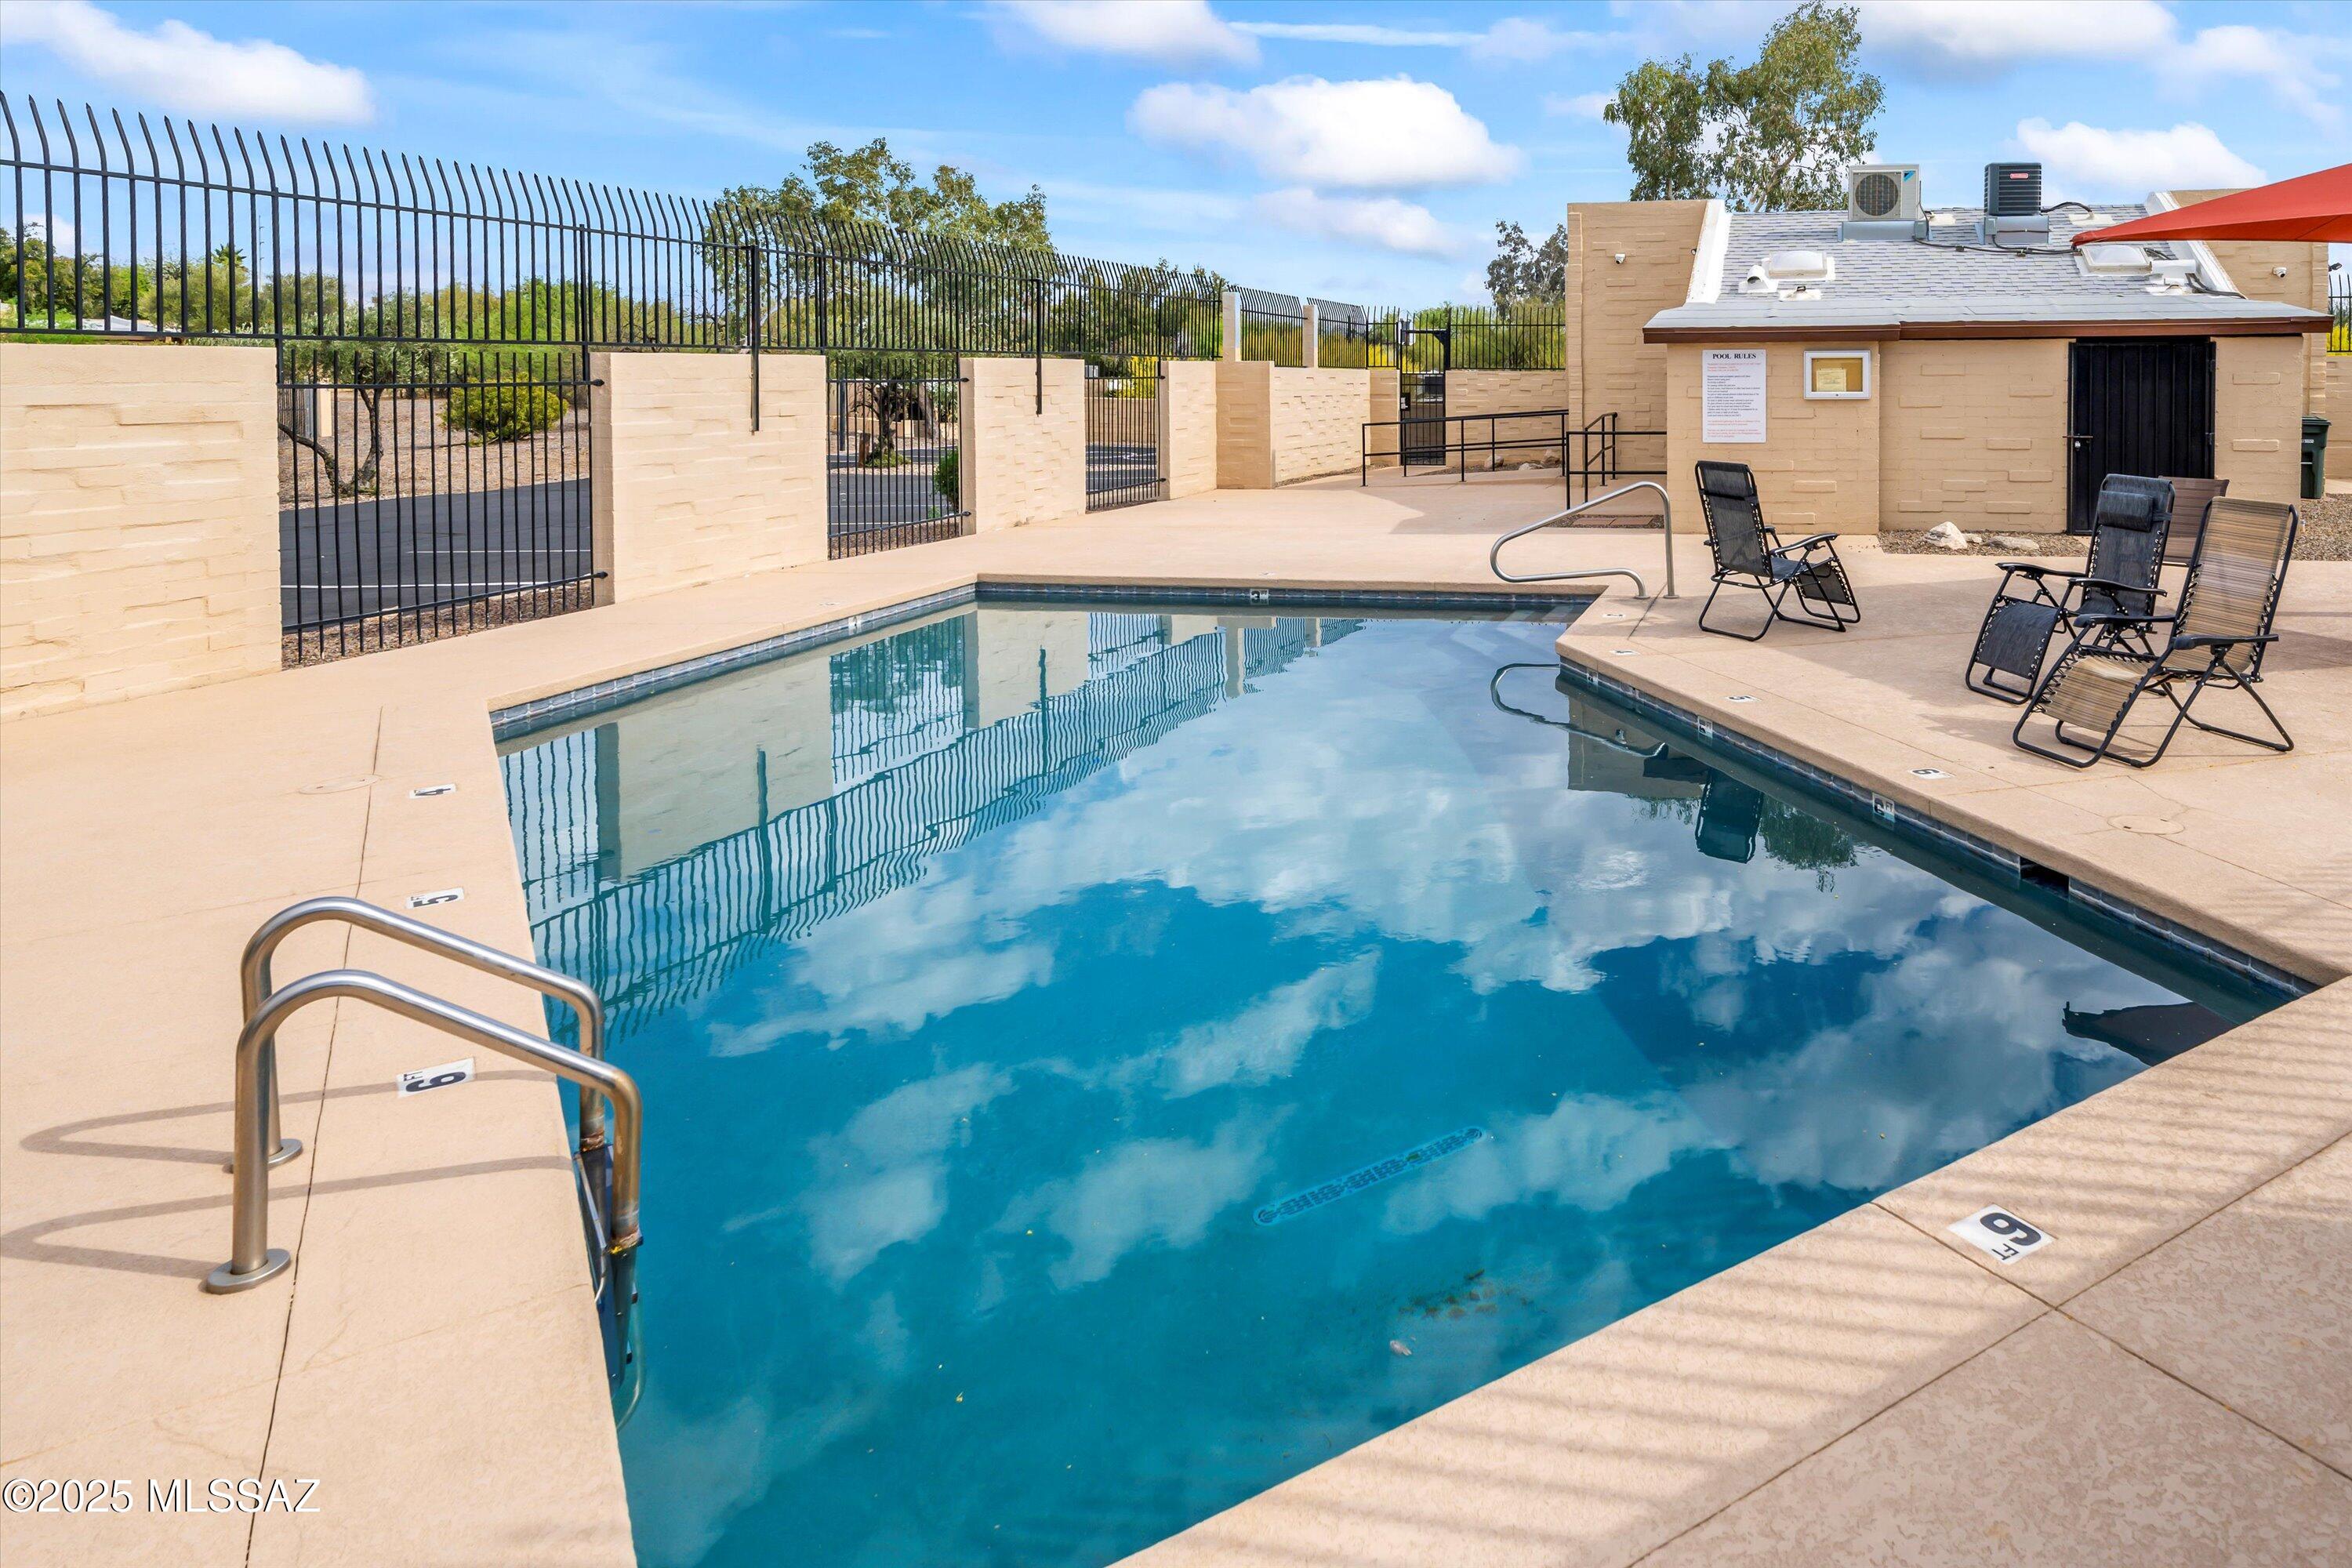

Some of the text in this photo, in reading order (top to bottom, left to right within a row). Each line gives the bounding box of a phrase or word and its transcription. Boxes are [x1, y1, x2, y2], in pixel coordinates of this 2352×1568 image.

[415, 788, 452, 797] 4
[412, 895, 459, 908] 5
[403, 1070, 466, 1092] 6 FT
[1980, 1212, 2042, 1261] 6 FT
